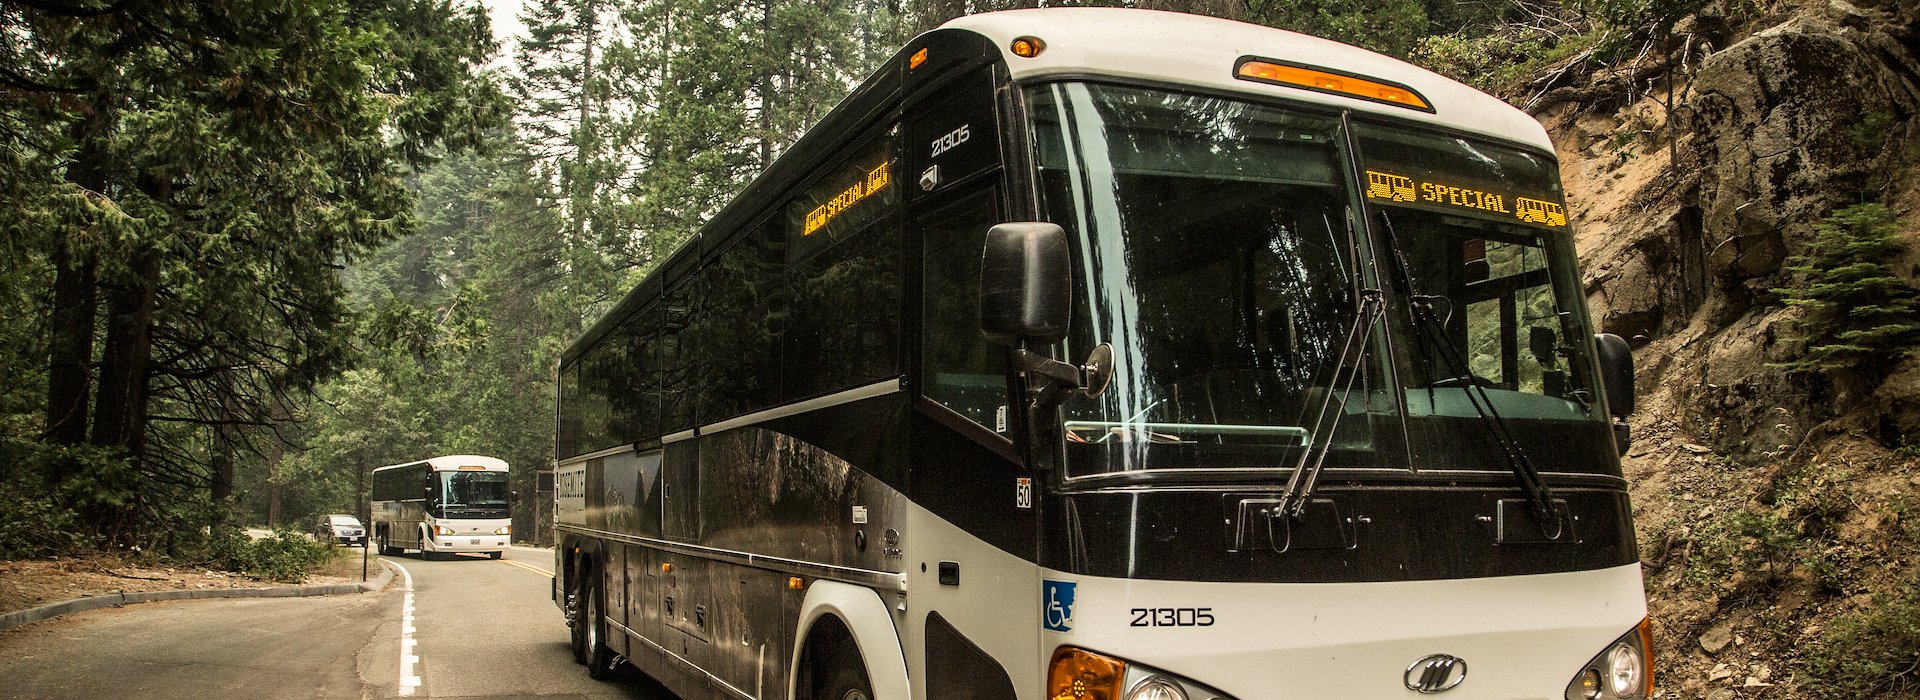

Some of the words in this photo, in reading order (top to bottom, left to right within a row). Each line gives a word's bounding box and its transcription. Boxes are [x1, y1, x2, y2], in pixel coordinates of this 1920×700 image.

[931, 123, 970, 158] 21305
[826, 181, 864, 219] SPECIAL
[1420, 182, 1510, 214] SPECIAL
[1018, 485, 1030, 507] 50
[1130, 607, 1215, 627] 21305
